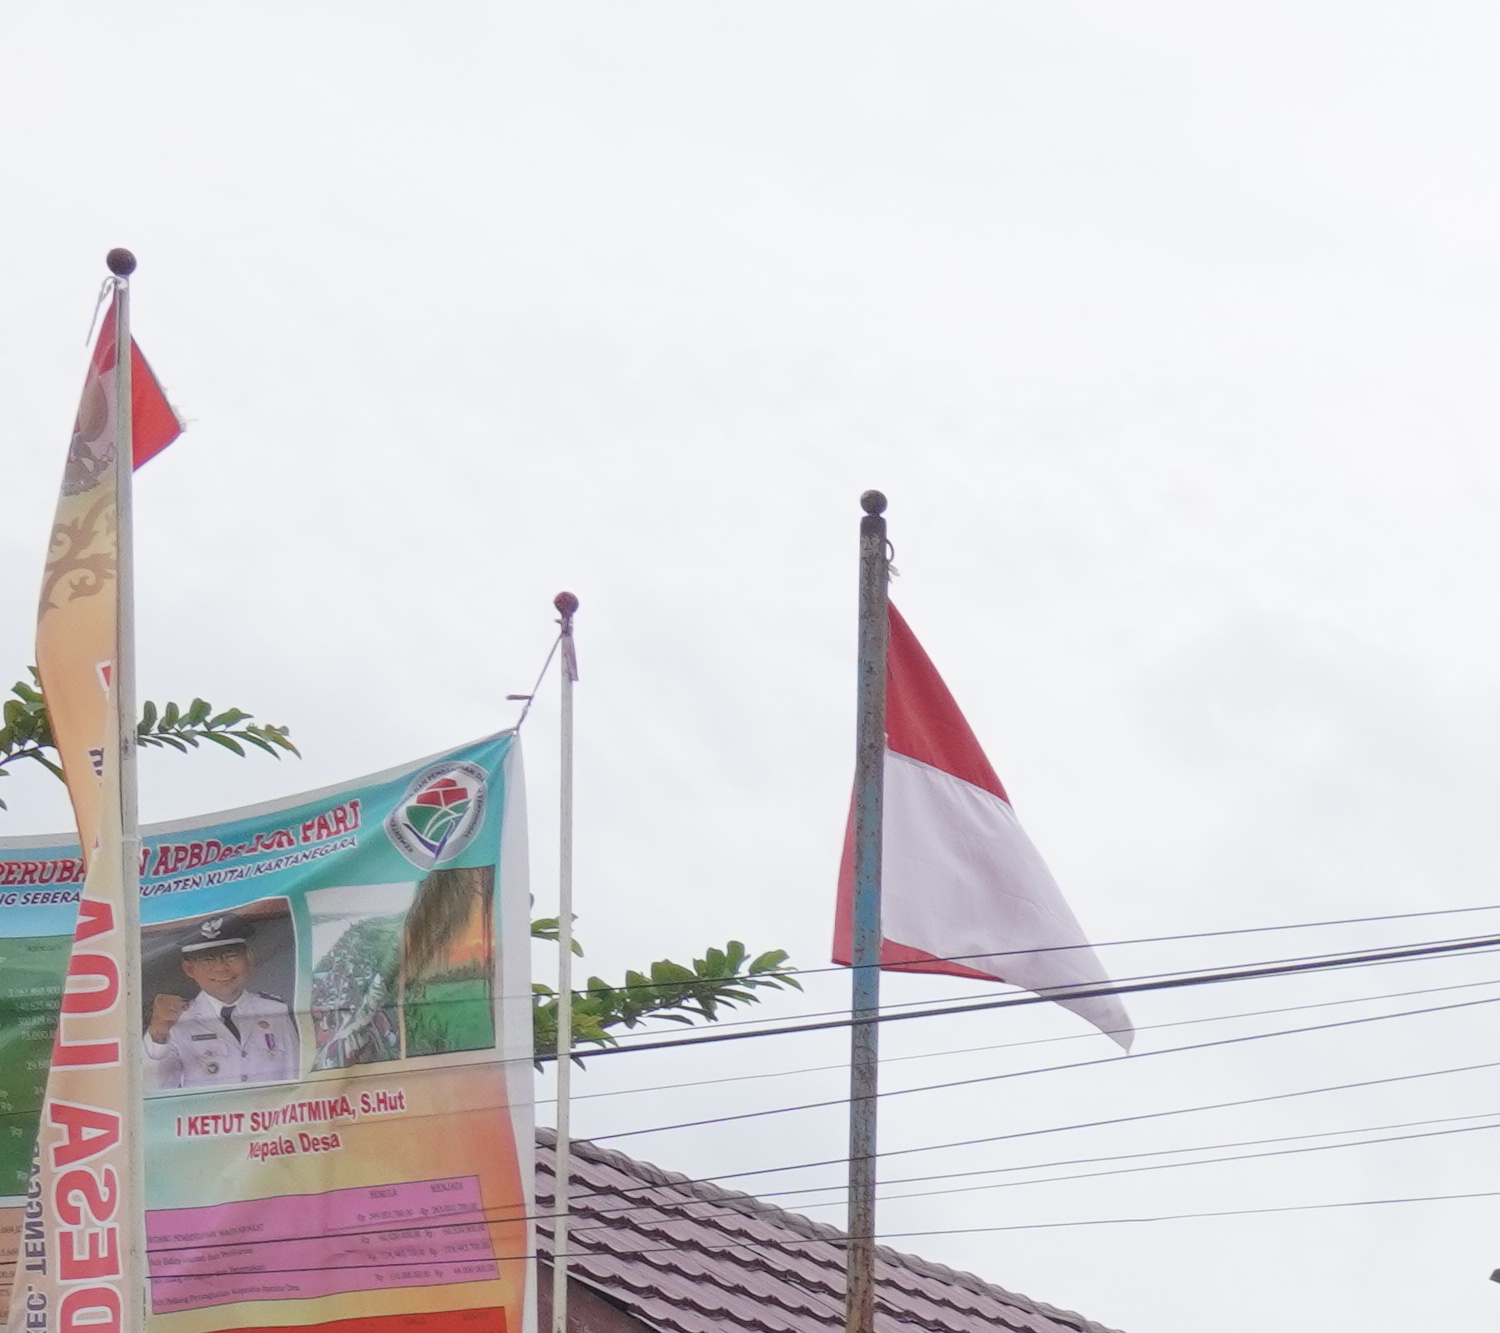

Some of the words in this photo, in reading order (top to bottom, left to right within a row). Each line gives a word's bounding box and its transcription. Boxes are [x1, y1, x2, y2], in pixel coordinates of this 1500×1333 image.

[252, 837, 358, 876] KARTANEGARA
[187, 1112, 245, 1136] KETUT
[360, 1090, 406, 1115] S.Hut
[299, 1131, 341, 1154] Desa
